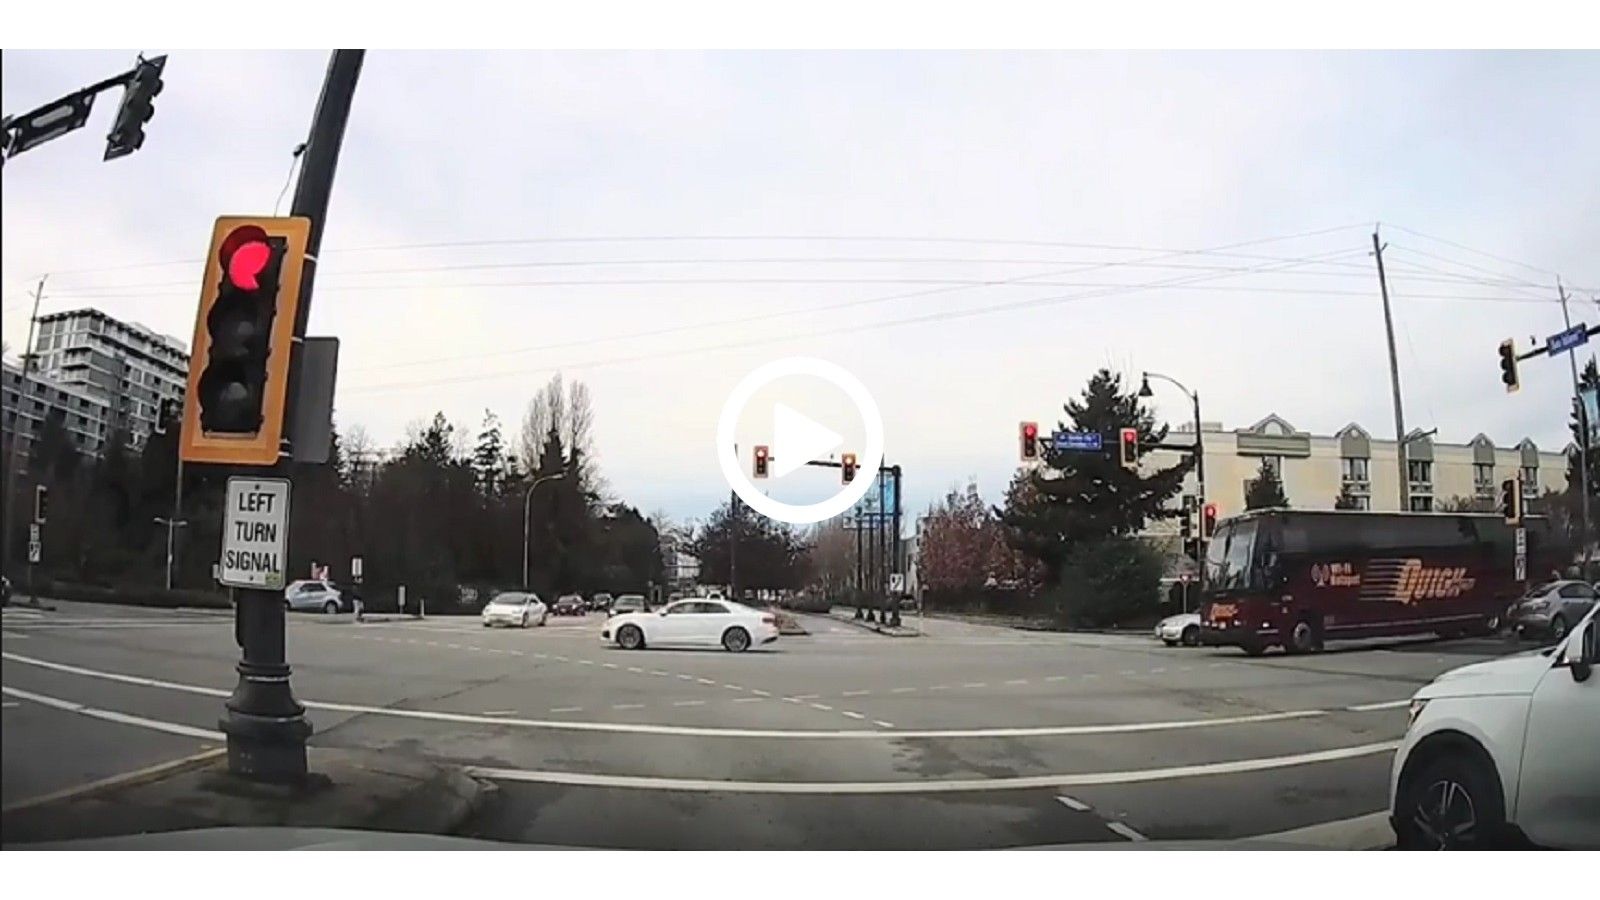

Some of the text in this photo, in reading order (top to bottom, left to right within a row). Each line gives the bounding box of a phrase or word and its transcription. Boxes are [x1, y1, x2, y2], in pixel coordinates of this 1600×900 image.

[238, 492, 277, 513] LEFT
[234, 521, 277, 542] TURN
[225, 550, 280, 573] SIGNAL
